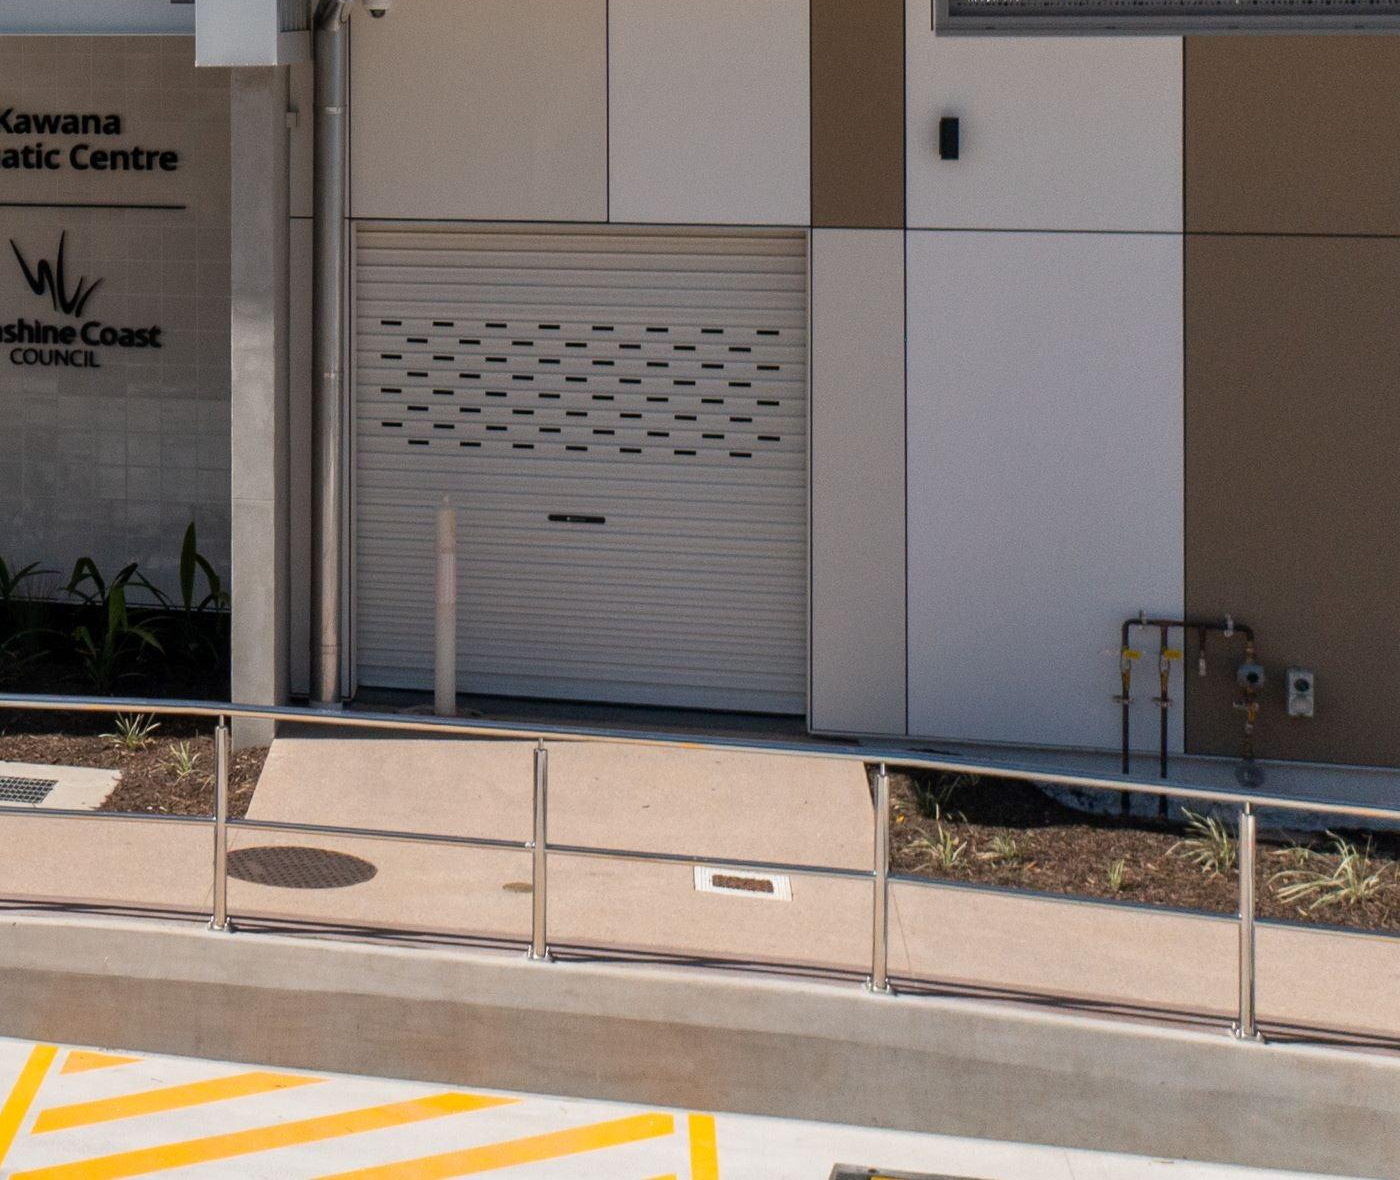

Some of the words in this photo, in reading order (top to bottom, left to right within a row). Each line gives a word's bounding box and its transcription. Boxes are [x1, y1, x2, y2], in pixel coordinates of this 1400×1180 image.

[69, 144, 178, 171] Centre
[80, 322, 162, 348] Coast
[10, 348, 100, 368] COUNCIL
